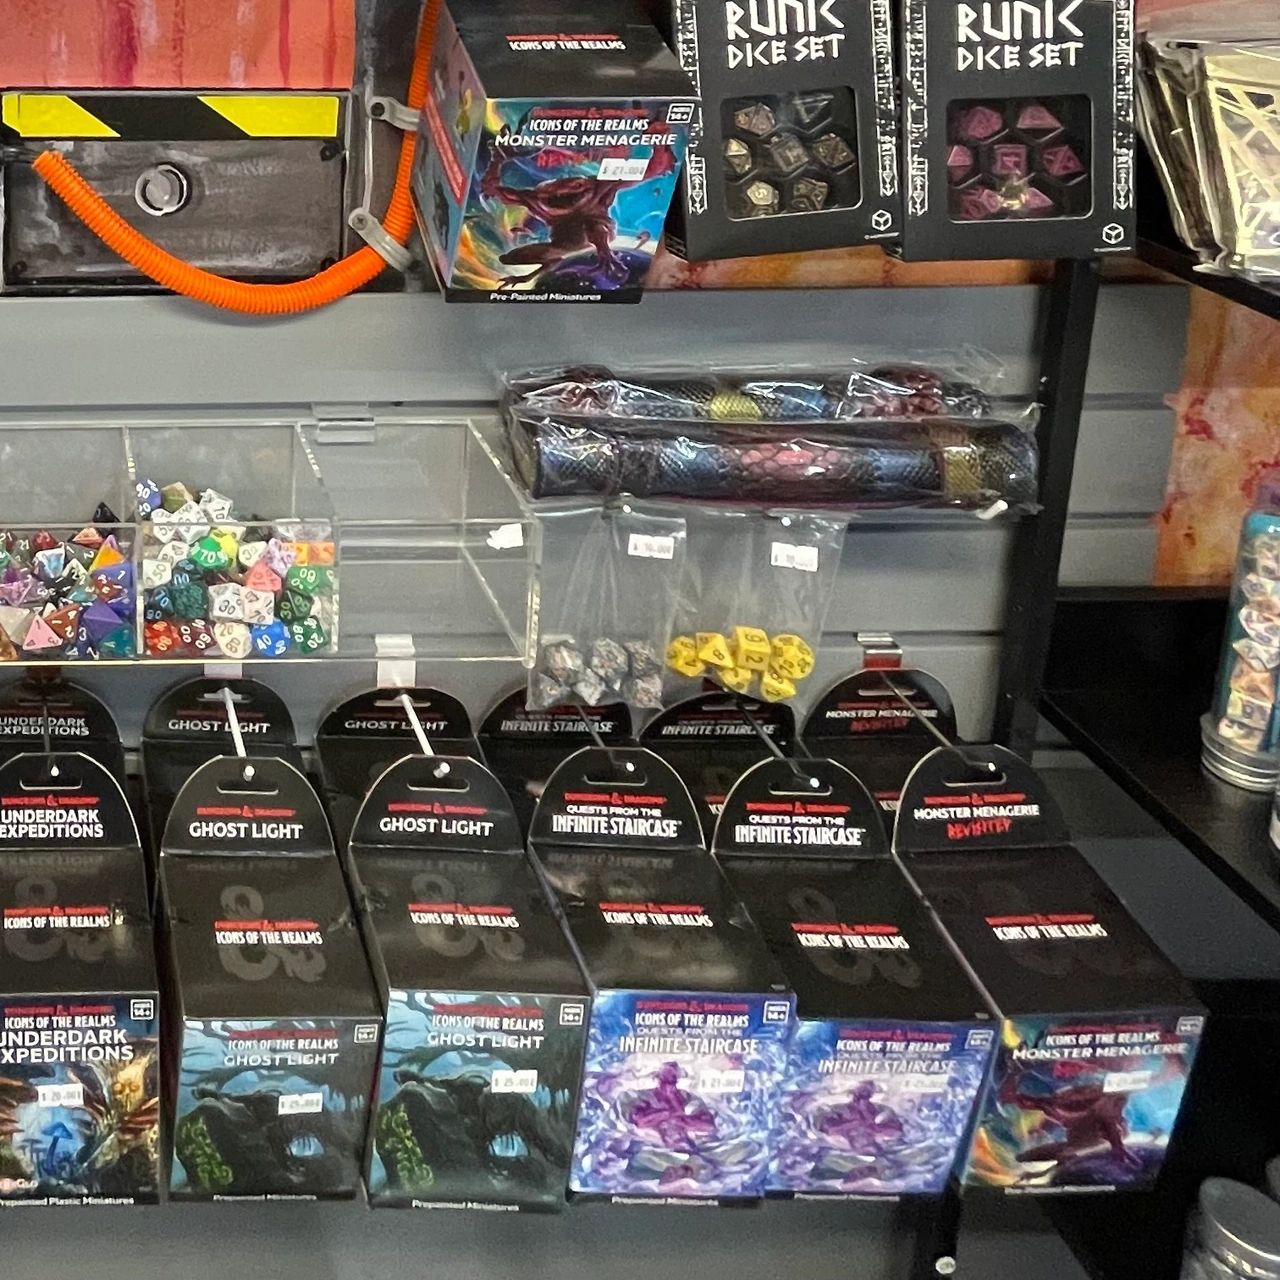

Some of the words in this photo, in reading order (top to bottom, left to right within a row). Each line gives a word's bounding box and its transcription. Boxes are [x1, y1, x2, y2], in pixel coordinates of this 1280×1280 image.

[957, 0, 1085, 42] RUNIC
[510, 41, 541, 50] ICONS
[542, 41, 557, 50] OF
[560, 40, 580, 50] THE
[581, 40, 626, 50] REALMS
[727, 40, 788, 70] DICE
[792, 35, 845, 62] SET
[957, 45, 1022, 73] DICE
[1028, 41, 1084, 69] SET
[529, 119, 562, 131] ICONS
[564, 120, 578, 130] OF
[580, 119, 602, 130] THE
[604, 119, 649, 131] REALMS
[494, 134, 577, 146] MONSTER
[580, 134, 678, 146] MENAGERIE
[490, 292, 547, 302] Pre-Painted
[549, 292, 601, 301] Miniatures
[826, 710, 876, 719] MONSTER
[168, 720, 220, 732] GHOST
[224, 721, 271, 734] LGHT
[345, 720, 399, 729] GHOST
[401, 721, 448, 730] LHT
[1, 809, 100, 823] UNDERDARK
[566, 806, 608, 814] QUESTS
[610, 807, 637, 815] FROM
[640, 808, 662, 817] THE
[914, 807, 971, 820] MONSTER
[972, 805, 1040, 817] MENAGERIE
[552, 815, 608, 834] INFINITE
[610, 819, 678, 838] STAIRCASE
[749, 815, 791, 824] QUESTS
[792, 816, 821, 824] FROM
[189, 822, 248, 838] GHOST
[252, 823, 304, 839] LIGHT
[379, 817, 438, 833] GHOST
[441, 820, 494, 837] LIGHT
[735, 825, 792, 844] INFINITE
[793, 826, 862, 846] STAIRCASE
[215, 931, 245, 944] ICONS
[246, 931, 259, 943] OF
[260, 931, 281, 944] THE
[282, 931, 323, 945] REALMS
[5, 1016, 32, 1029] ICONS
[34, 1016, 50, 1029] OF
[51, 1016, 72, 1028] THE
[74, 1015, 116, 1028] REALMS
[432, 1015, 461, 1027] ICONS
[462, 1016, 477, 1028] OF
[479, 1017, 500, 1030] THE
[501, 1018, 545, 1031] REALMS
[635, 1013, 666, 1026] ICONS
[667, 1013, 682, 1026] OF
[684, 1013, 705, 1027] THE
[706, 1013, 749, 1028] REALMS
[228, 1040, 258, 1051] ICONS
[259, 1040, 273, 1050] OF
[275, 1039, 296, 1050] THE
[297, 1038, 339, 1050] REALMS
[427, 1032, 485, 1047] GHOST
[490, 1034, 545, 1049] LIGHT
[620, 1036, 684, 1053] INFINITE
[685, 1038, 760, 1054] STAIRCASE
[836, 1039, 868, 1052] ICONS
[870, 1039, 884, 1051] OF
[886, 1040, 908, 1052] THE
[909, 1041, 952, 1052] REALMS
[1045, 1034, 1077, 1046] ICONS
[1078, 1034, 1094, 1045] OF
[1095, 1033, 1116, 1044] THE
[1117, 1032, 1161, 1043] REALMS
[1012, 1047, 1092, 1060] MONSTER
[1094, 1042, 1190, 1056] MENAGERIE
[224, 1055, 282, 1067] GHOST
[287, 1053, 340, 1066] LIGHT
[818, 1059, 882, 1073] INFINITE
[885, 1060, 958, 1074] STAIRCASE
